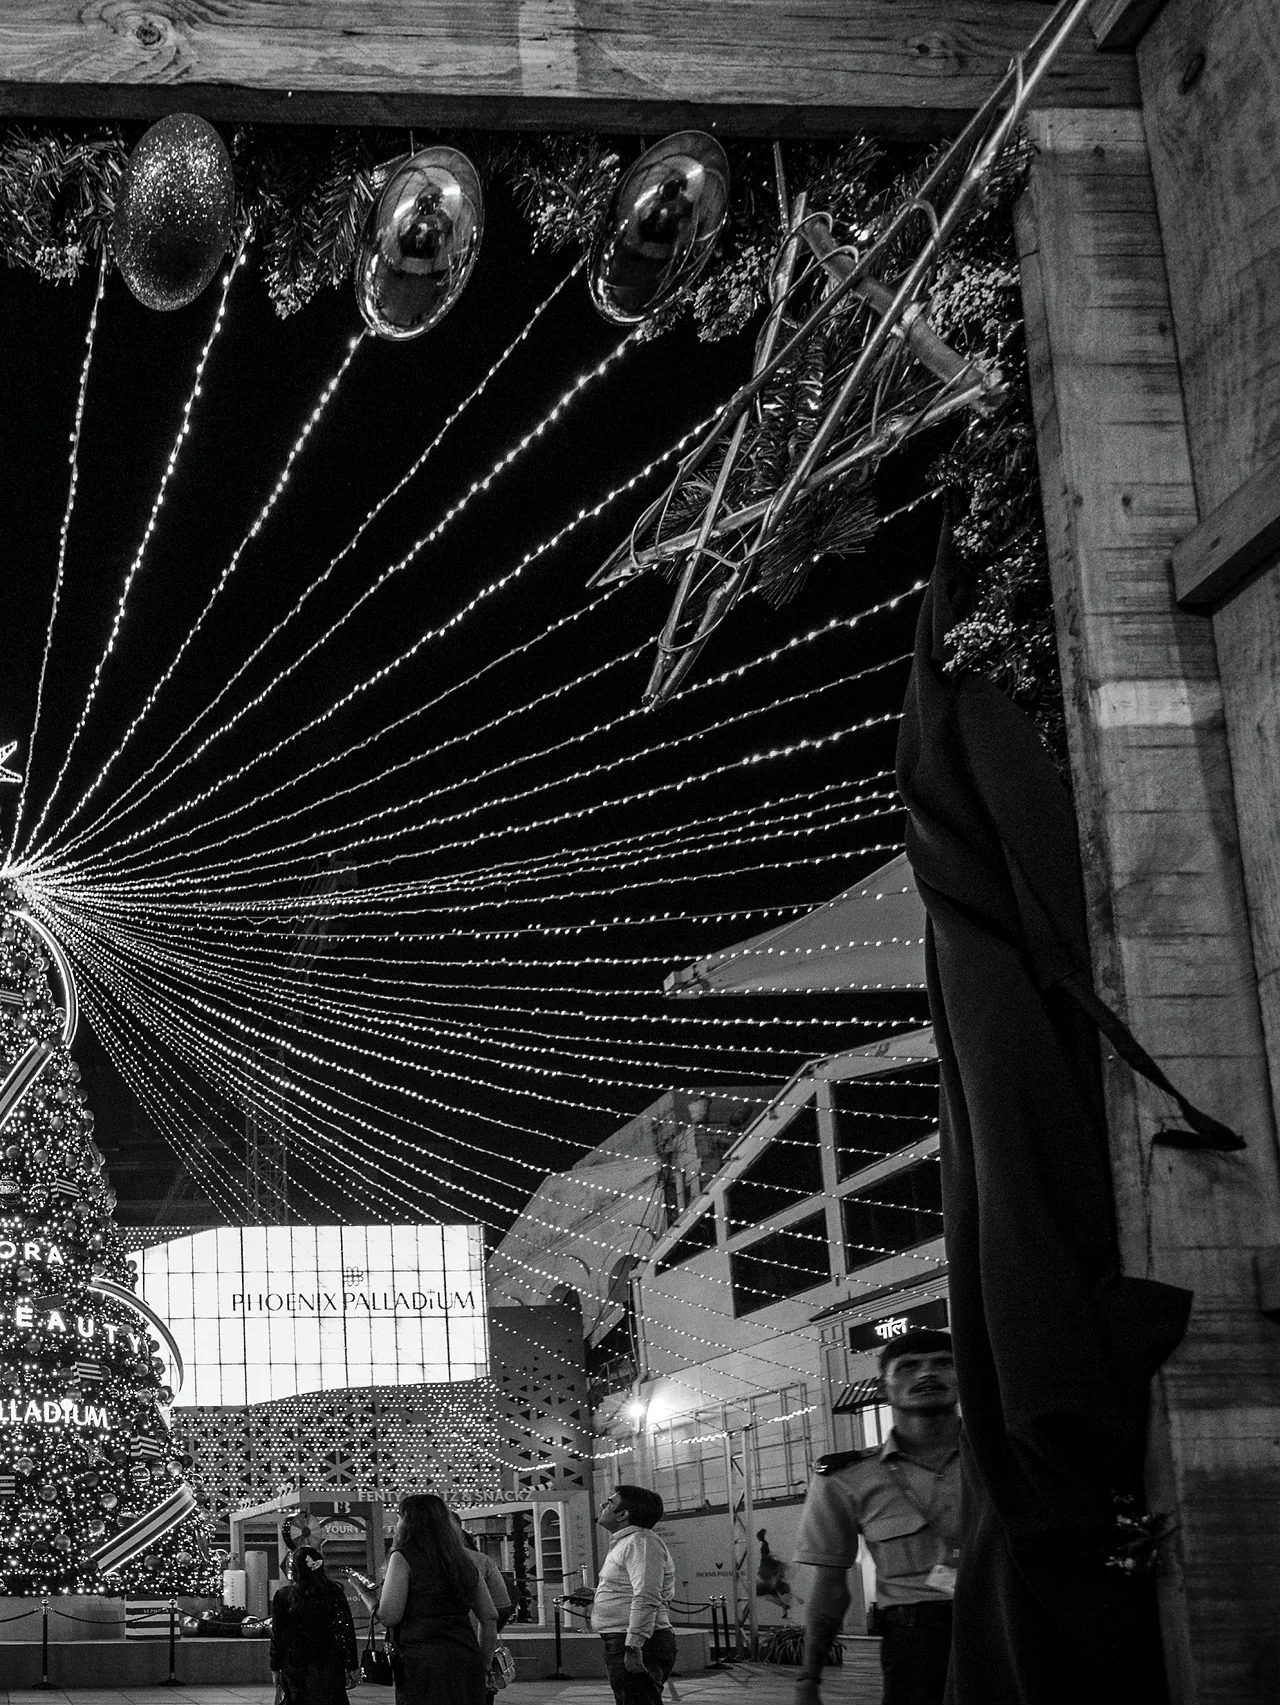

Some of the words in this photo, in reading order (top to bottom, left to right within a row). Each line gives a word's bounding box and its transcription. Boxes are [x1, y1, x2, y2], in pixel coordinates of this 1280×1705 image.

[231, 1293, 337, 1312] PHOENIX
[358, 1490, 404, 1502] FENTY
[474, 1490, 534, 1502] SNACKZ
